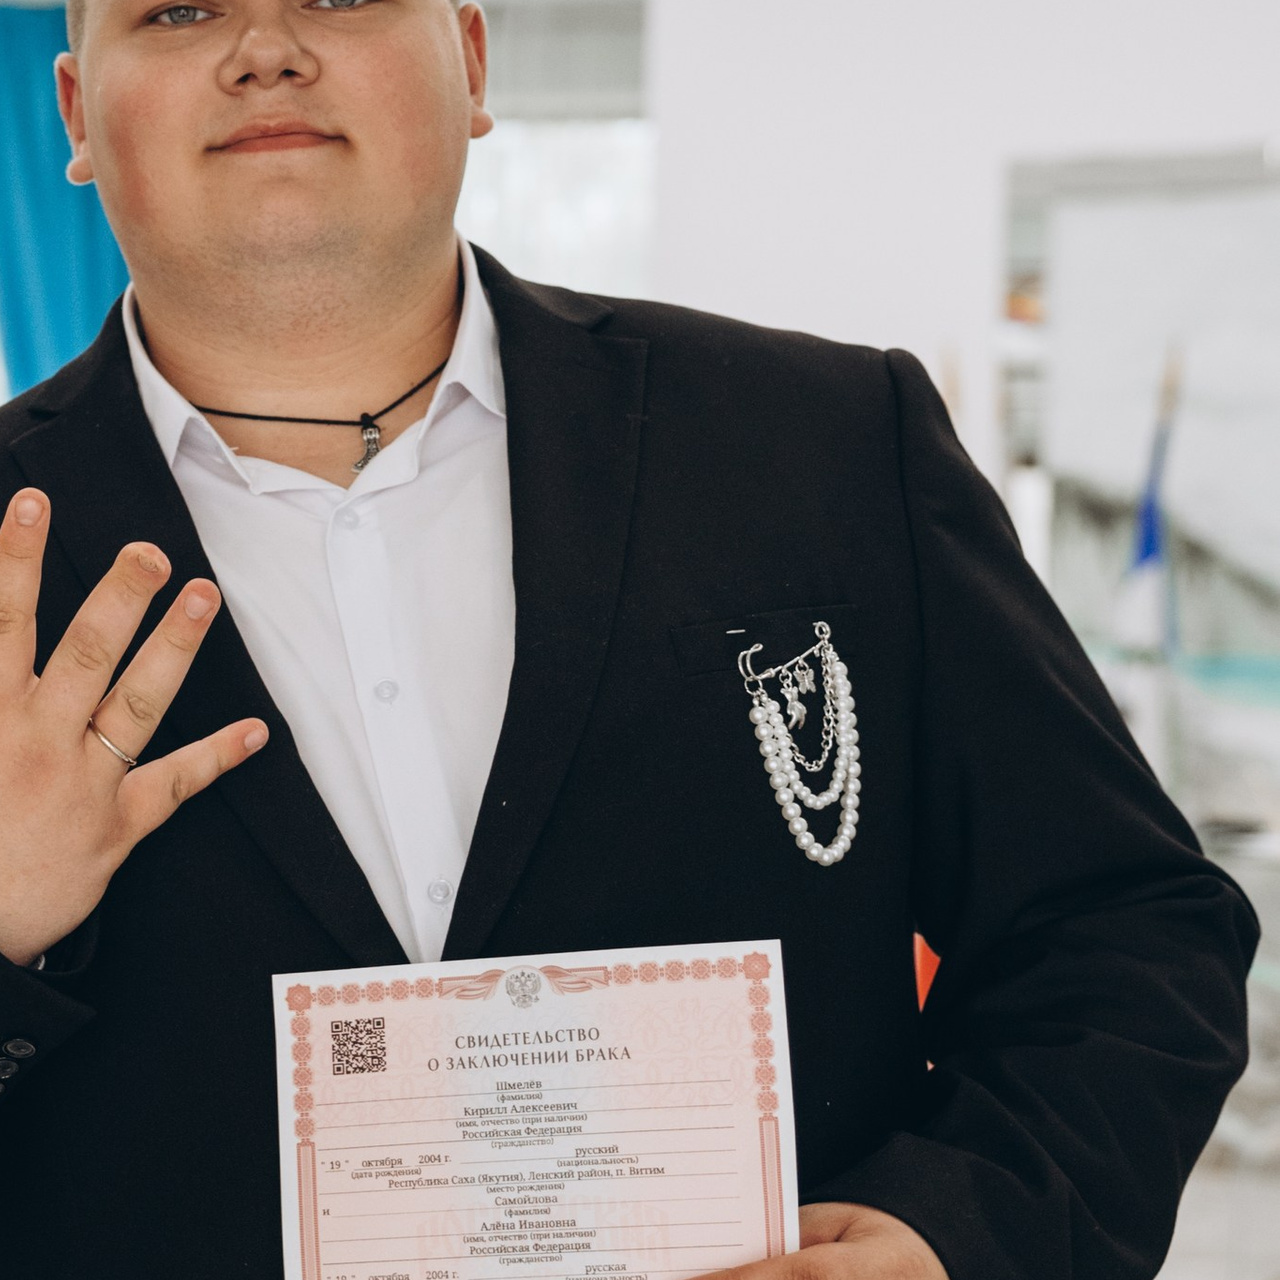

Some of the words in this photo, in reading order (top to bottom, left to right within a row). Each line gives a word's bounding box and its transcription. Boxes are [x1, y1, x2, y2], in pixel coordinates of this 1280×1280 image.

[455, 1027, 600, 1050] СВИДЕТЕЛЬСТВО
[427, 1057, 440, 1071] О
[446, 1050, 569, 1070] ЗАКЛЮЧЕНИИ
[576, 1046, 631, 1063] БРАКА
[496, 1080, 542, 1091] Шмелёв
[463, 1106, 508, 1117] Кирилл
[510, 1102, 578, 1114] Алексеевич
[481, 1117, 520, 1126] отчество
[462, 1129, 522, 1140] Российская
[524, 1124, 582, 1137] Федерация
[575, 1145, 619, 1157] русский
[330, 1160, 341, 1170] 19
[361, 1157, 403, 1168] октября
[418, 1155, 441, 1164] 2004
[388, 1176, 449, 1189] Республика
[451, 1175, 475, 1184] Саха
[528, 1169, 575, 1180] Ленский
[578, 1168, 613, 1180] район,
[629, 1166, 665, 1175] Витим
[494, 1194, 558, 1206] Самойлова
[322, 1208, 330, 1216] и
[480, 1220, 516, 1231] Алёна
[519, 1218, 576, 1229] Ивановна
[488, 1233, 527, 1242] отчество
[470, 1243, 530, 1255] Российская
[533, 1241, 591, 1253] Федерация
[425, 1270, 449, 1279] 2004
[585, 1263, 626, 1274] русская
